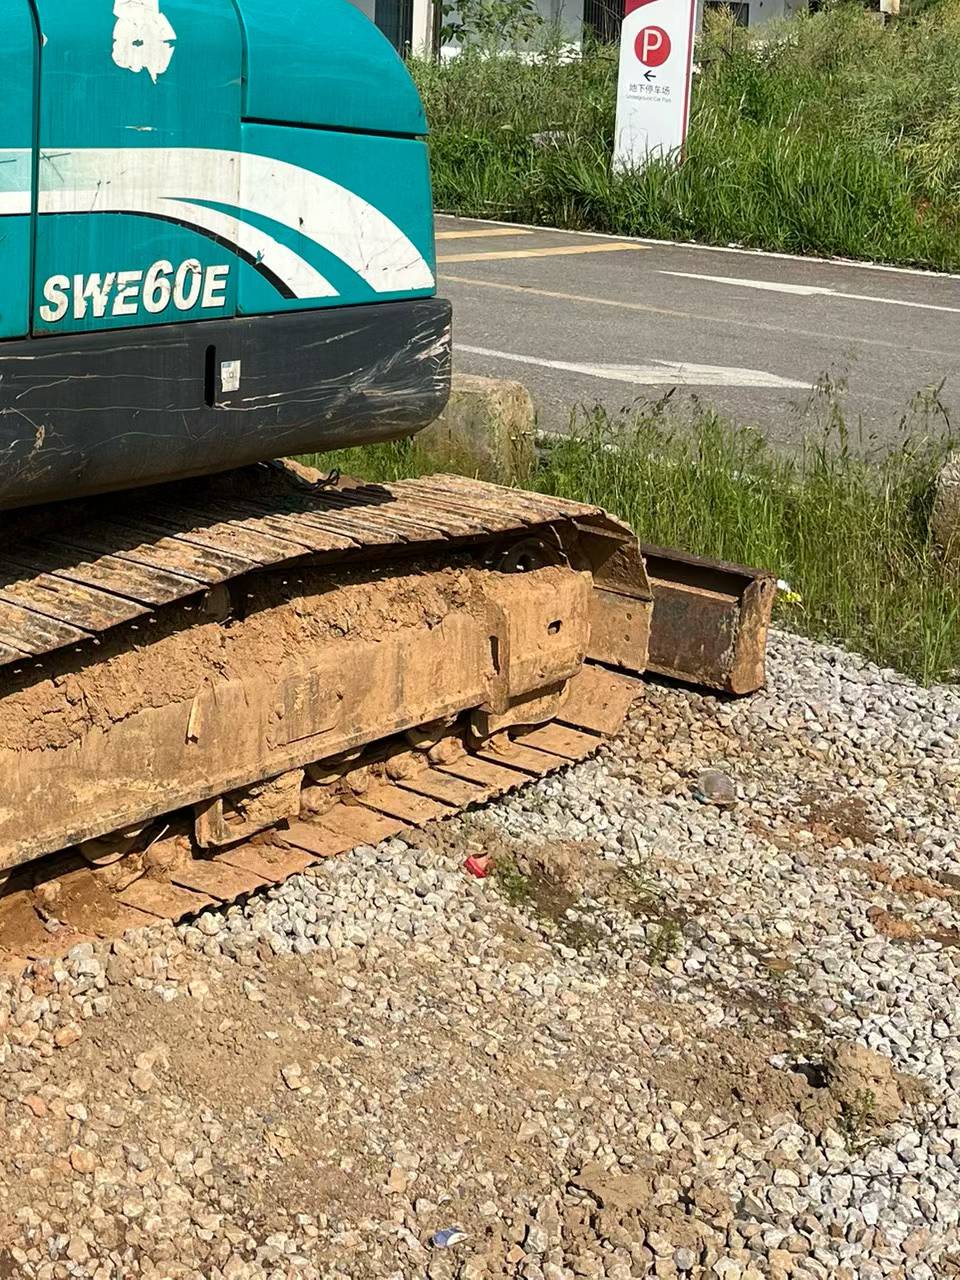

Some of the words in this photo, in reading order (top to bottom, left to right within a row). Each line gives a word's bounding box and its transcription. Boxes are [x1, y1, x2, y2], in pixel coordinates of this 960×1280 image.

[642, 28, 663, 62] P
[628, 83, 671, 96] 地下停车场
[40, 258, 230, 322] SWE60E
